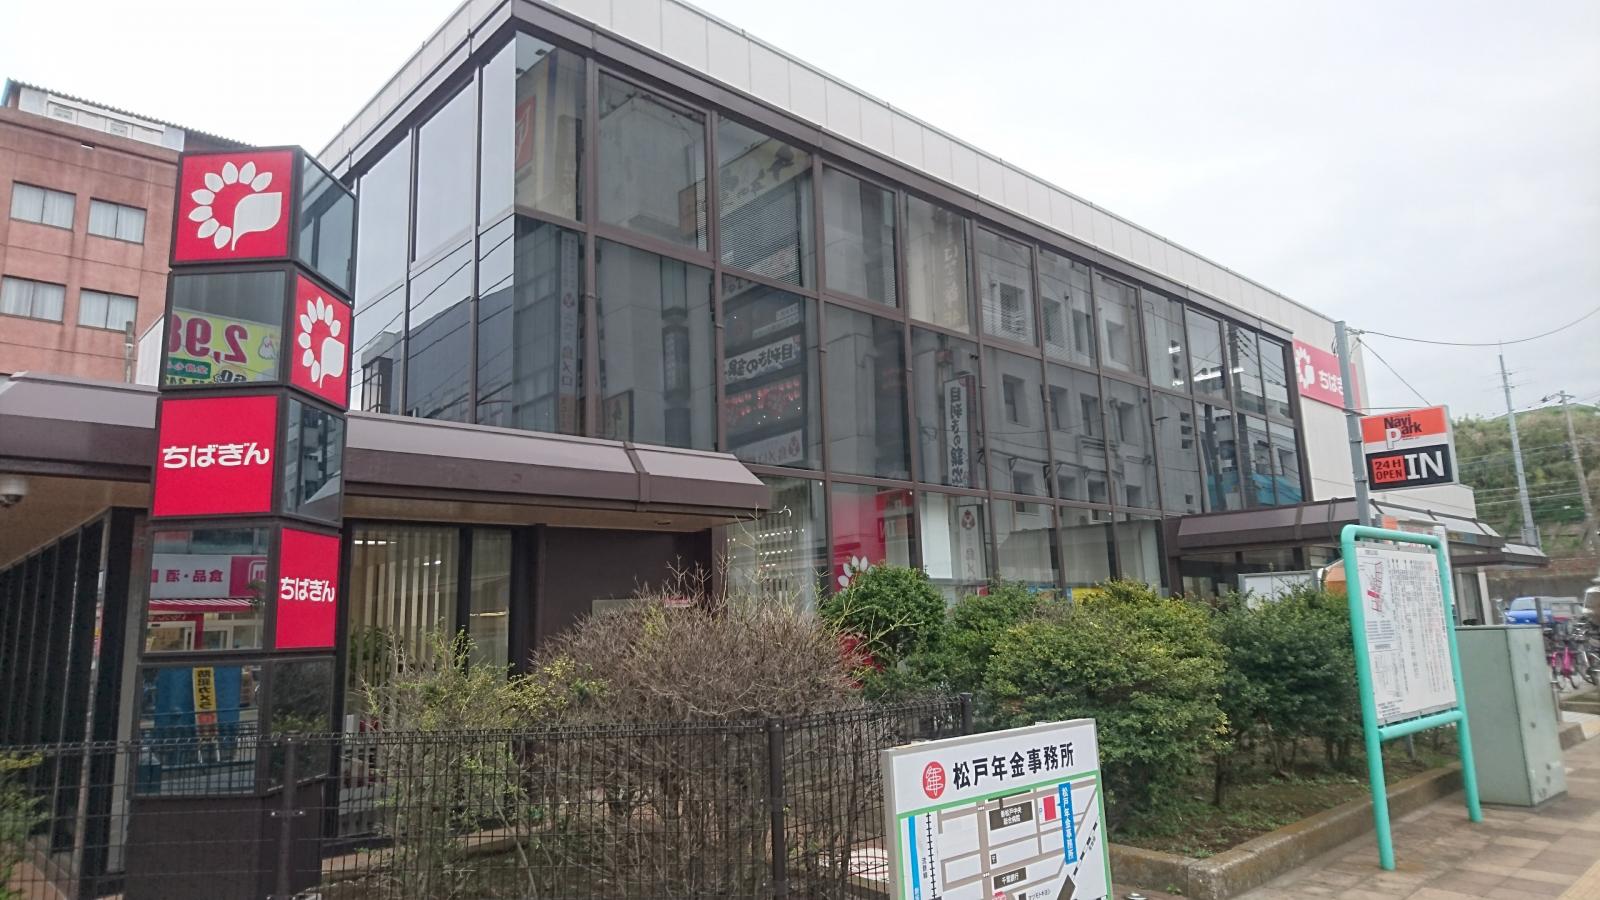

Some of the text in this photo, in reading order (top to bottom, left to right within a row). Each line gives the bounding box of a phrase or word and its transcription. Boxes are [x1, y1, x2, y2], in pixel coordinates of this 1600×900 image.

[1384, 414, 1412, 430] Navi
[1385, 421, 1422, 450] Park
[162, 442, 270, 469] ちばぎん
[1404, 451, 1445, 480] IN
[1375, 469, 1402, 481] OPEN
[280, 576, 335, 603] ちばぎん
[952, 742, 1074, 790] 松戸年金事務所
[1062, 787, 1075, 861] 松戸年金事務所
